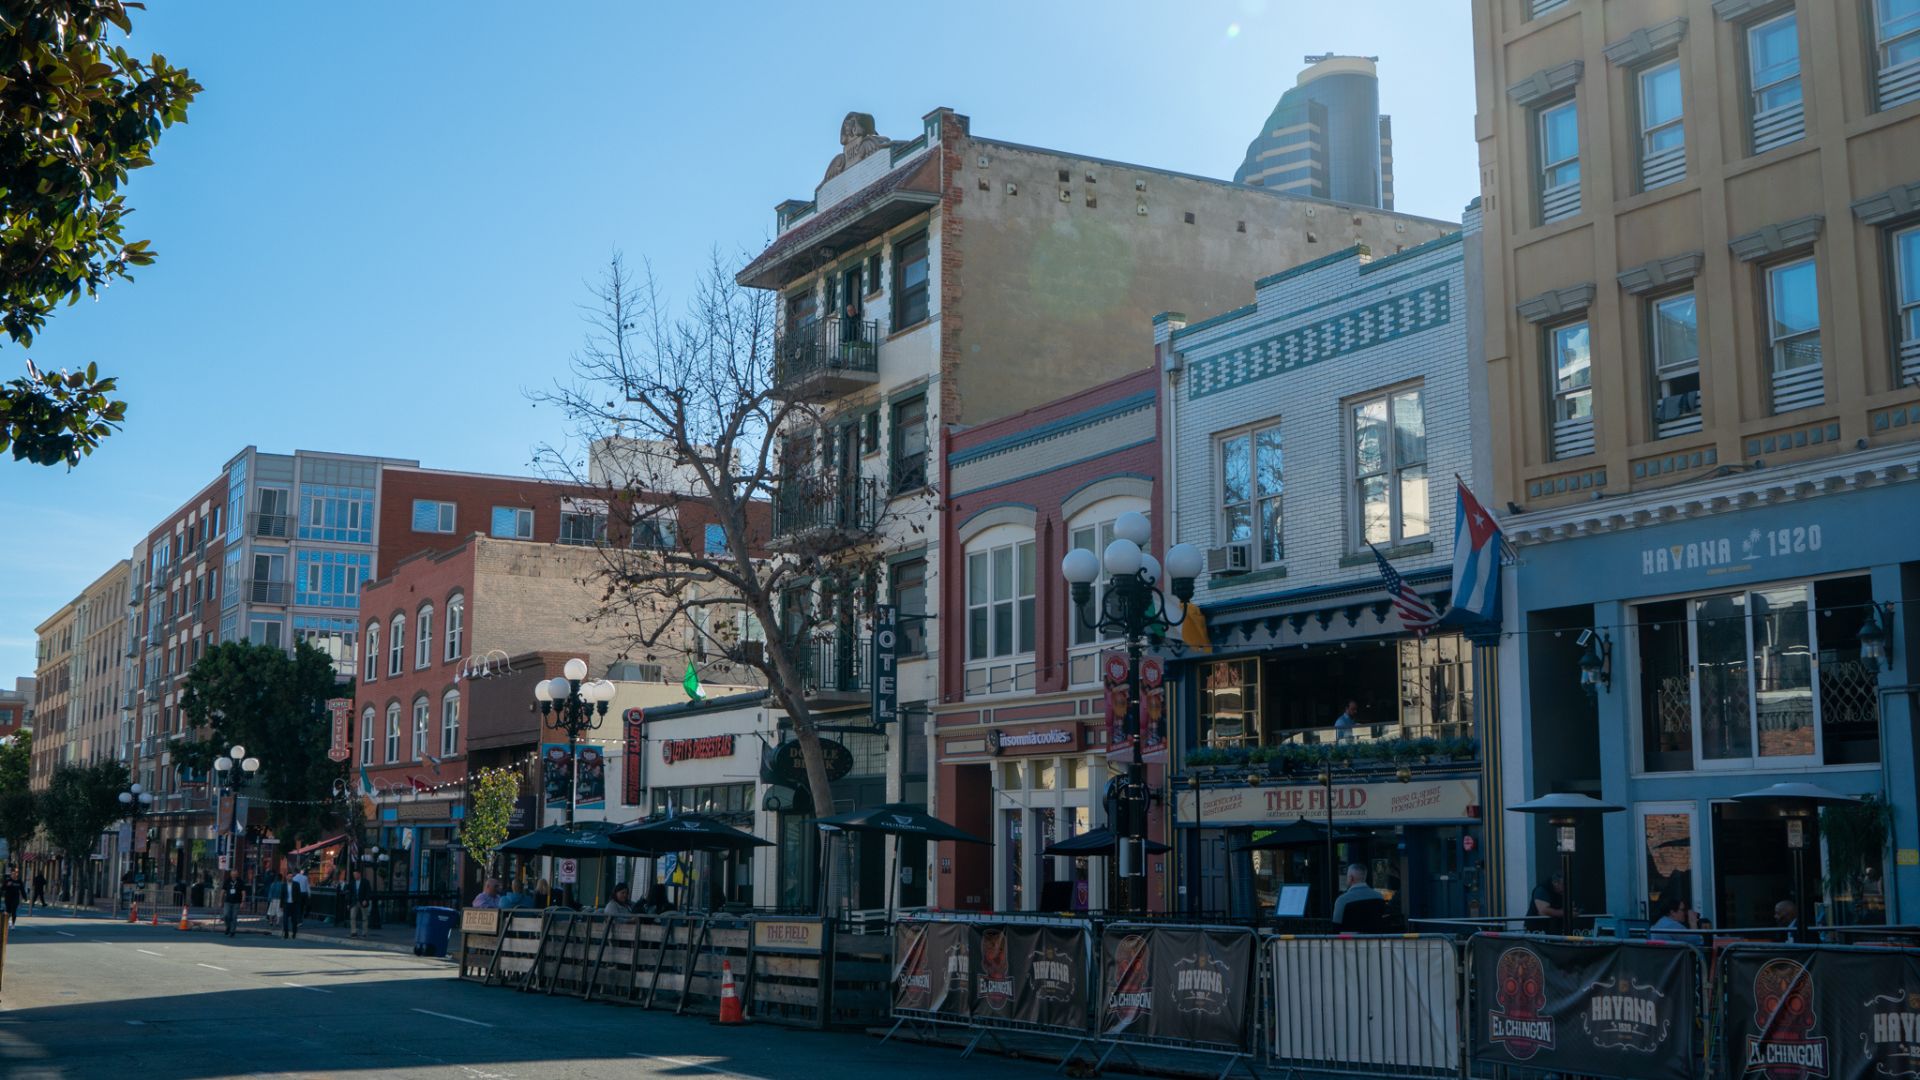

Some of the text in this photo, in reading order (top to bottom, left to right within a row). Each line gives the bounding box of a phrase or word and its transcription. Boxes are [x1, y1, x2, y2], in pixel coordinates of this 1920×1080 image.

[1642, 524, 1822, 576] HAVANA 1920
[879, 606, 897, 718] HOTEL
[335, 710, 344, 750] HOTEL
[1000, 730, 1068, 747] insomnia cookies
[1264, 787, 1368, 811] THE FIELD
[466, 911, 495, 926] THE FIELD
[767, 925, 809, 940] THE FIELD
[1032, 960, 1070, 984] HAVANA
[1178, 969, 1223, 994] HAVANA
[1118, 992, 1152, 1010] CHINGON
[1591, 995, 1657, 1027] HAVANA
[1492, 1015, 1552, 1043] EL CHINGON
[1766, 1043, 1824, 1070] CHINGON
